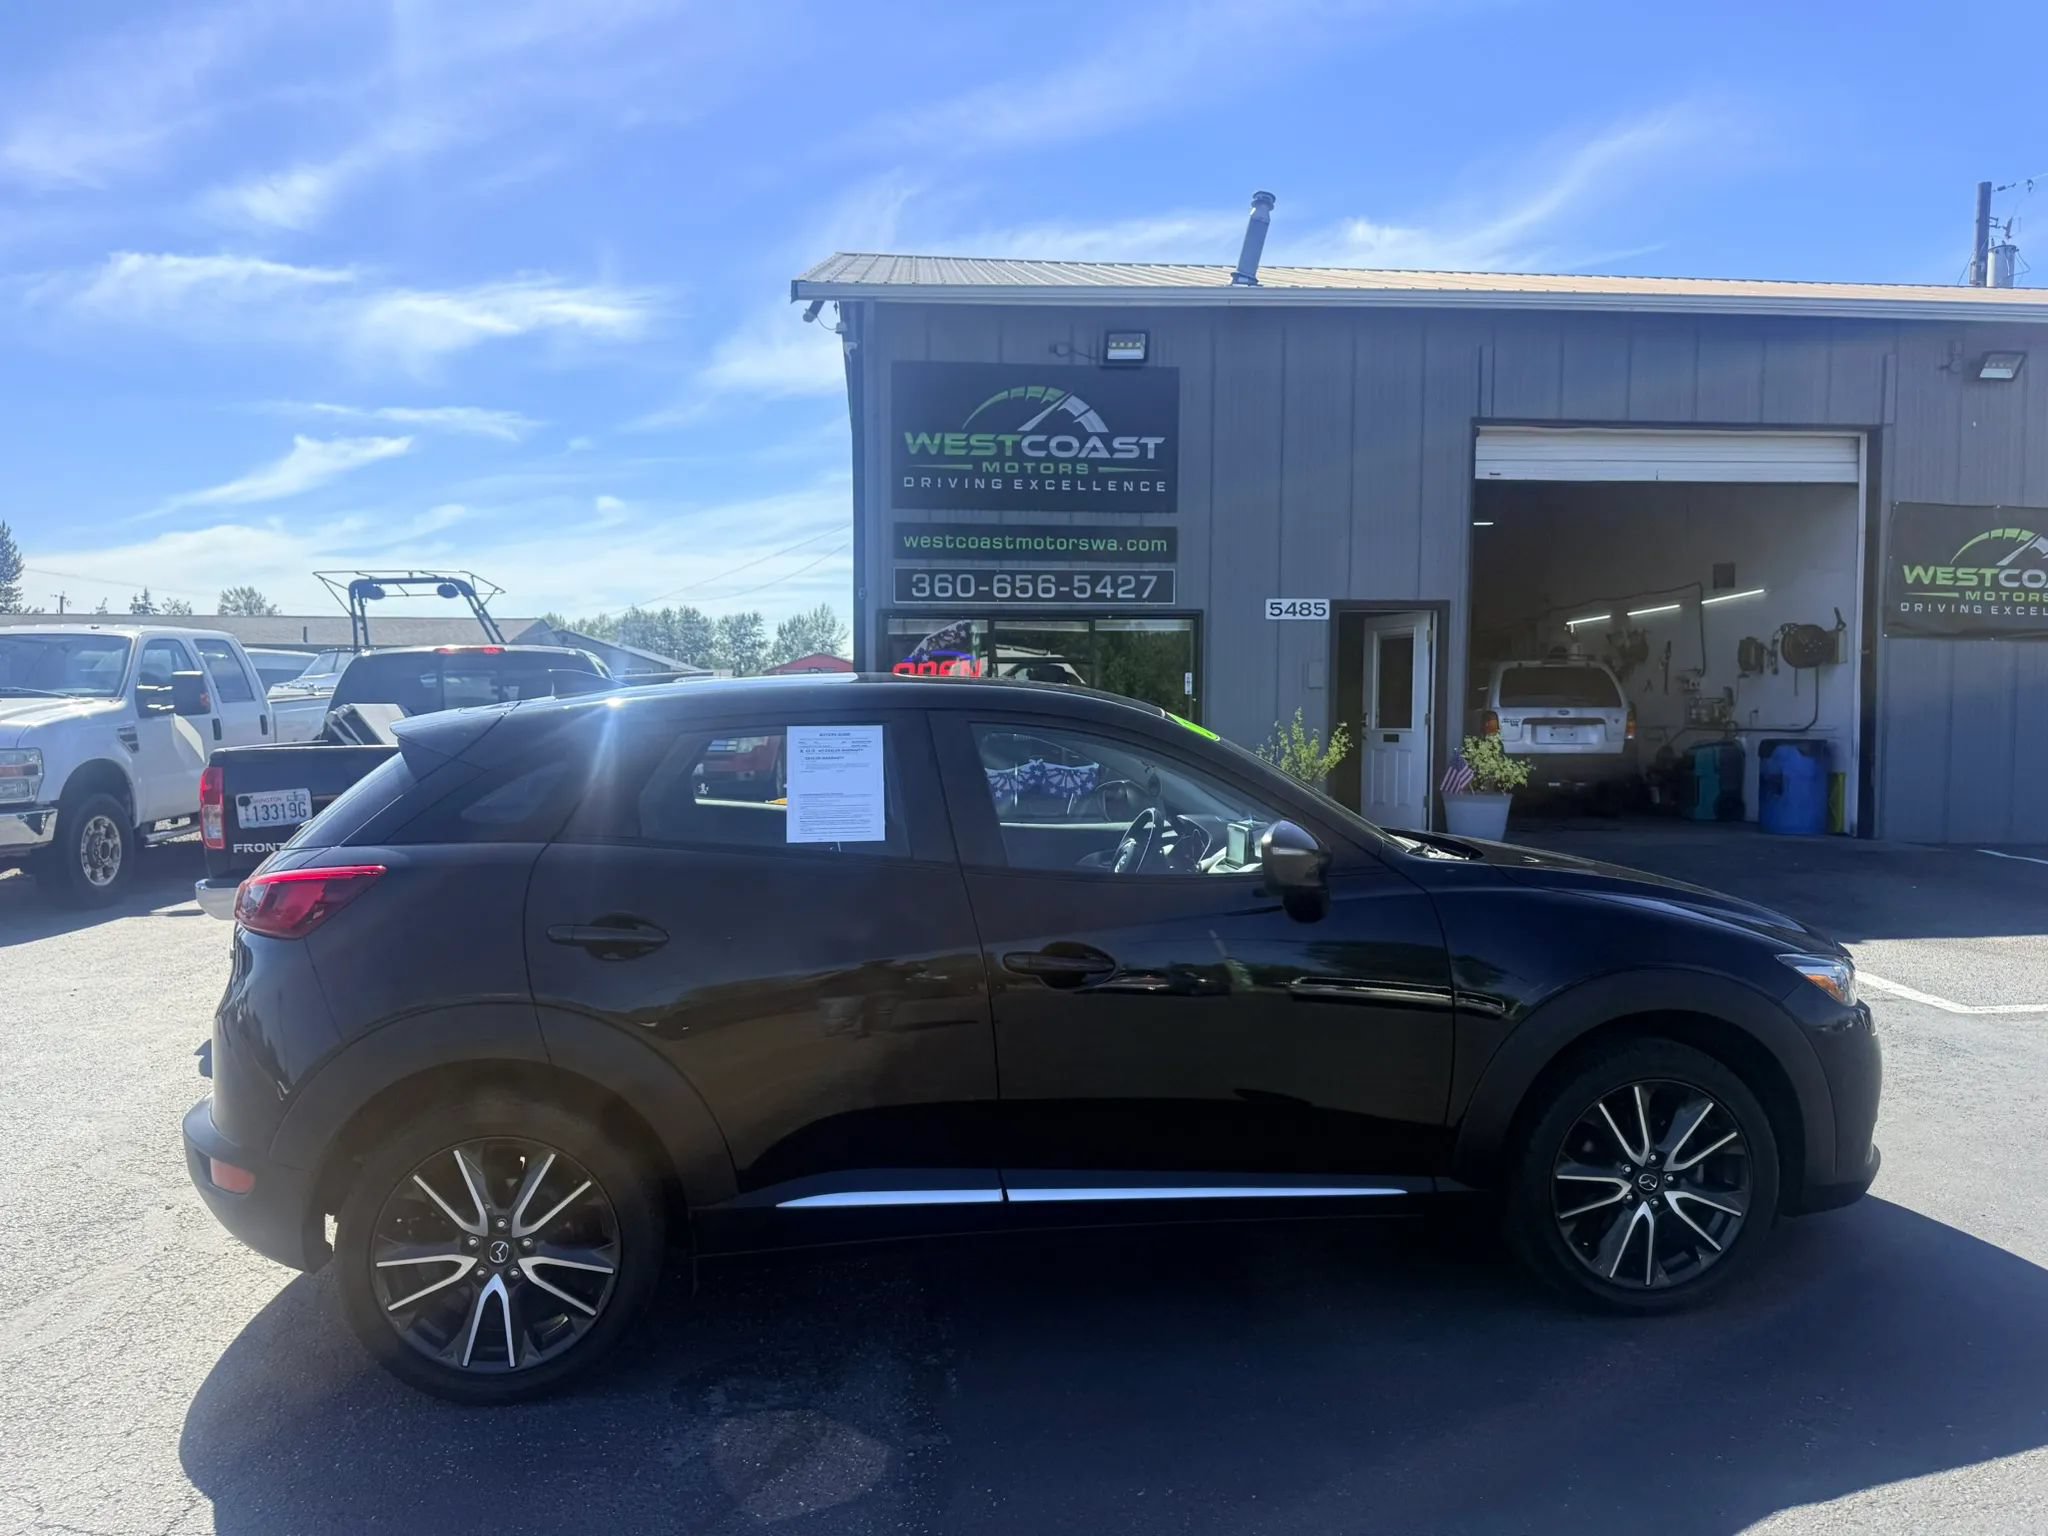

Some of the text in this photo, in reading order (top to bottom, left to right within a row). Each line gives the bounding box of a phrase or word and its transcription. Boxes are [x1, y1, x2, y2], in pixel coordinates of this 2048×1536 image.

[904, 432, 1166, 460] WESTCOAST
[982, 461, 1089, 475] MOTORS
[903, 476, 1166, 493] DRIVING EXCELLENCE
[903, 534, 1167, 552] westcoastmotorswa.com
[1903, 564, 2048, 589] WESTCO
[911, 573, 1158, 599] 360-656-5427
[1269, 601, 1327, 617] 5485
[1900, 602, 1983, 615] DRIVING
